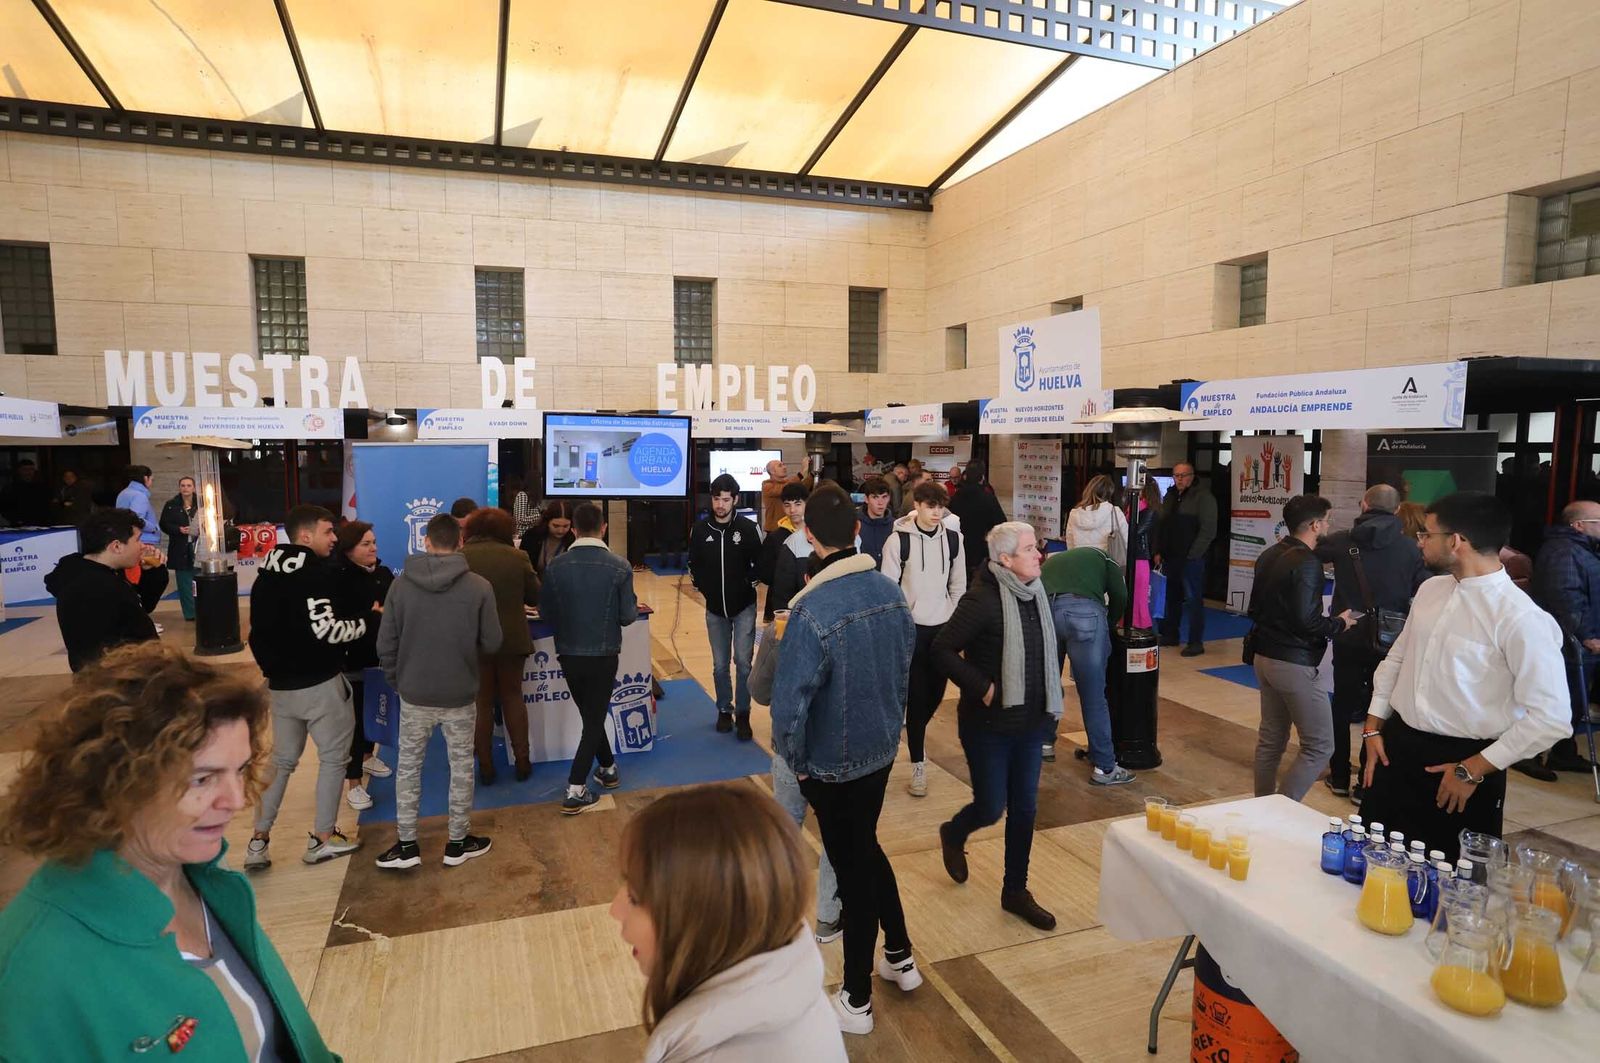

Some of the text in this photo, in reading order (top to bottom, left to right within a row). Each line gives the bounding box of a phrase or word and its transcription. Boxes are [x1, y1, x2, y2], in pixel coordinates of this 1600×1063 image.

[104, 350, 816, 412] MUESTRA DE EMPLEO
[1039, 373, 1082, 391] HUELVA
[1200, 393, 1236, 402] MUESTRA
[1256, 388, 1347, 399] Fundación Pública Andaluza
[1034, 404, 1064, 412] HORIZONTES
[1202, 409, 1233, 417] EMPLEO
[1249, 402, 1353, 414] ANDALUCÍA EMPRENDE
[919, 414, 930, 423] UGT
[635, 446, 677, 457] AGENDA
[633, 456, 678, 465] URBANA
[261, 532, 270, 541] P
[0, 553, 39, 563] MUESTRA
[5, 565, 37, 574] EMPLEO
[522, 669, 567, 682] UESTR
[536, 682, 549, 692] de
[523, 691, 571, 704] MPLEO
